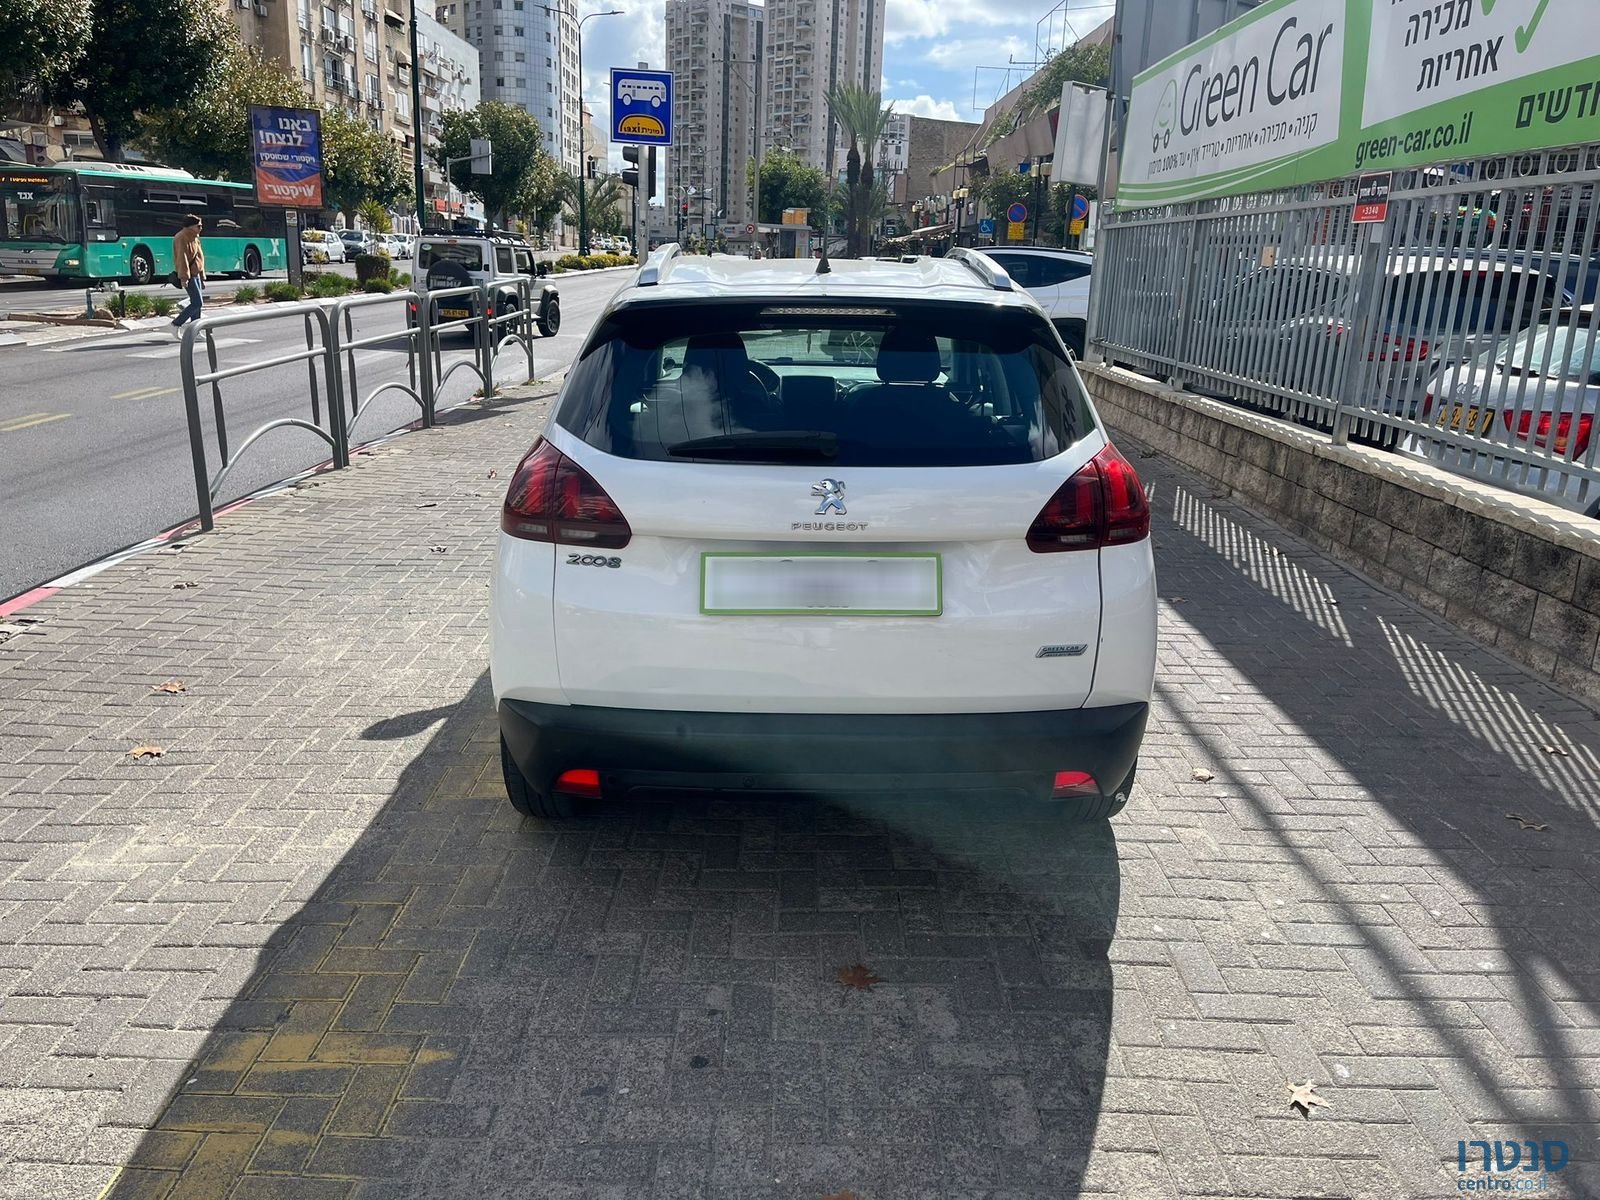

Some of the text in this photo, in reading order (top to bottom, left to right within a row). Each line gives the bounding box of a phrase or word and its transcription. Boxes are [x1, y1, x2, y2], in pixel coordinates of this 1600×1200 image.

[1404, 0, 1473, 47] מכירה
[1180, 16, 1334, 137] Green Car
[1416, 35, 1504, 92] אחריות
[259, 130, 302, 146] לנצח!
[278, 117, 312, 132] באנו
[1355, 111, 1473, 169] green-car.co.il
[791, 521, 868, 531] PEUGEOT
[566, 553, 622, 569] 2008
